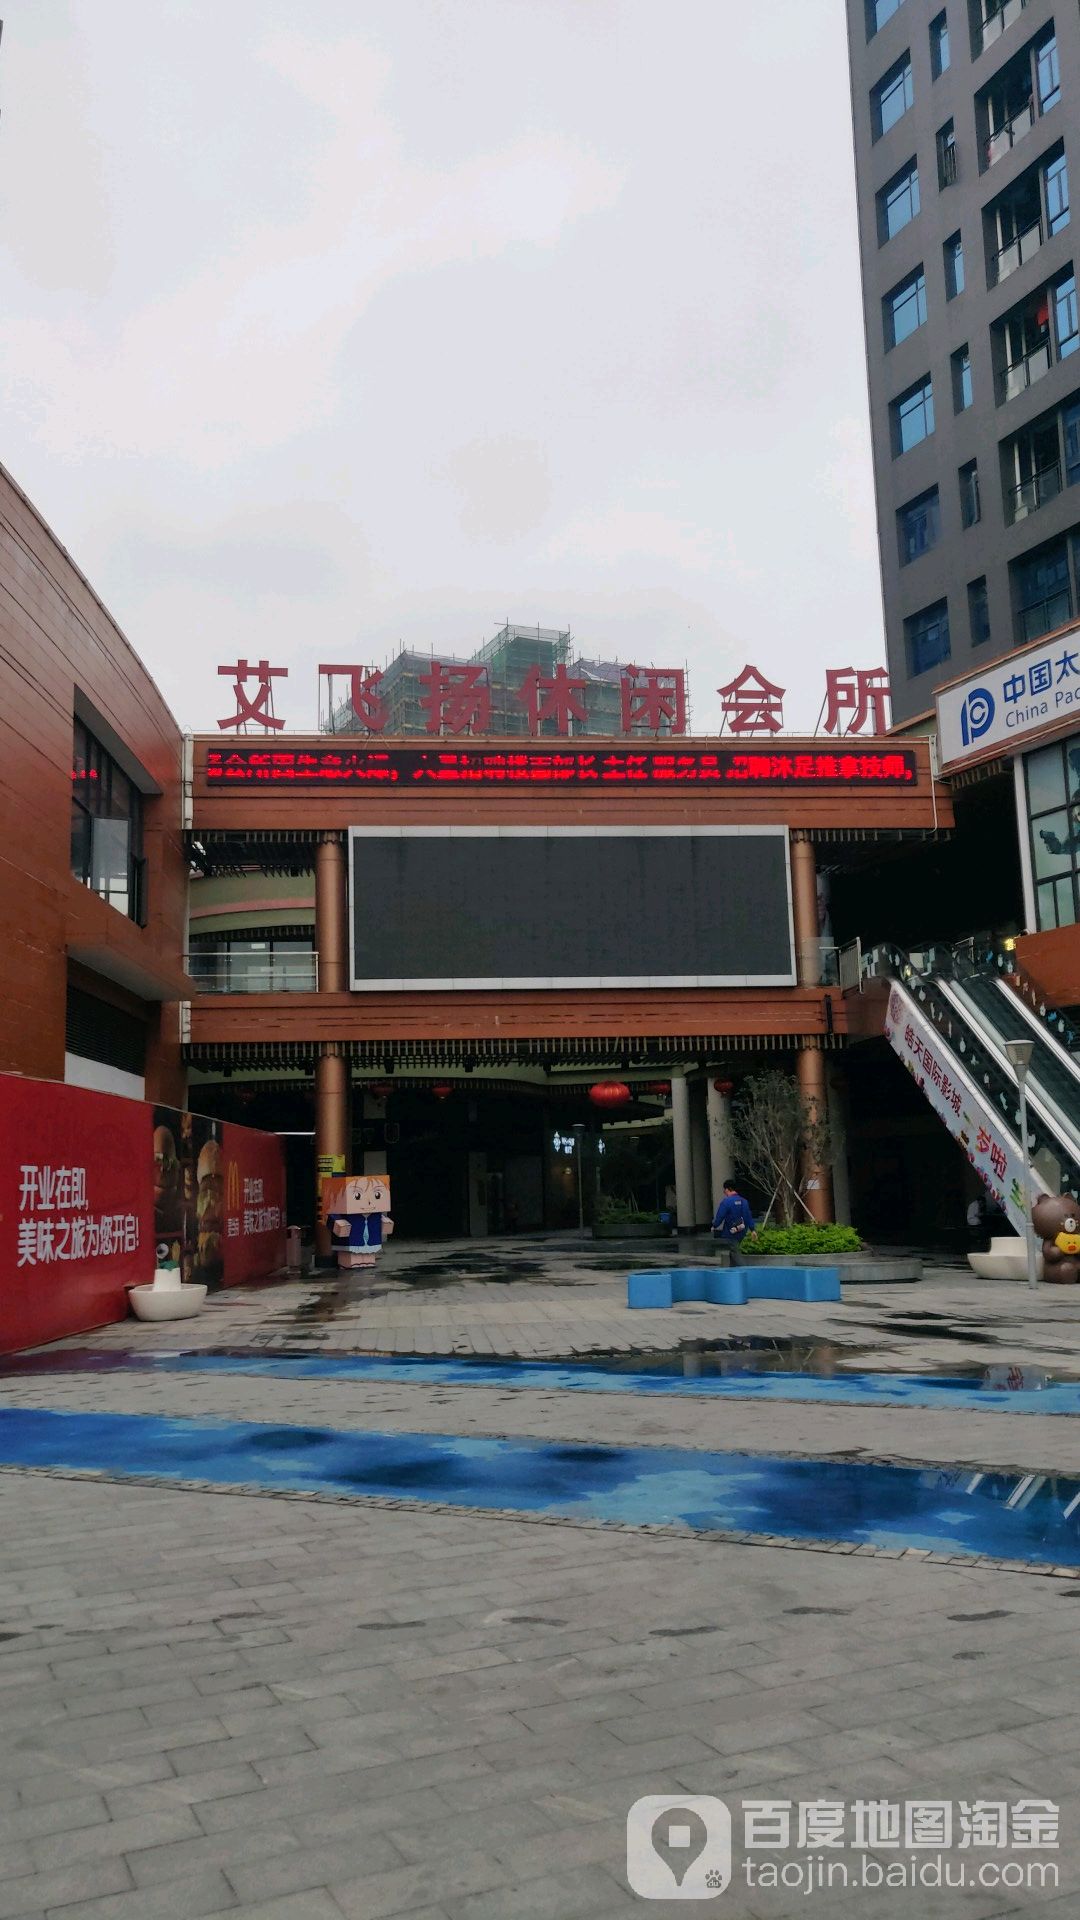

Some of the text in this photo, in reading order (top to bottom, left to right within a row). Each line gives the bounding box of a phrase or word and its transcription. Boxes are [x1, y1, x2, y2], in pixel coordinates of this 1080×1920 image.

[217, 659, 891, 736] 艾飞扬休闲会所
[1003, 650, 1080, 704] 中国太
[1006, 702, 1048, 728] China
